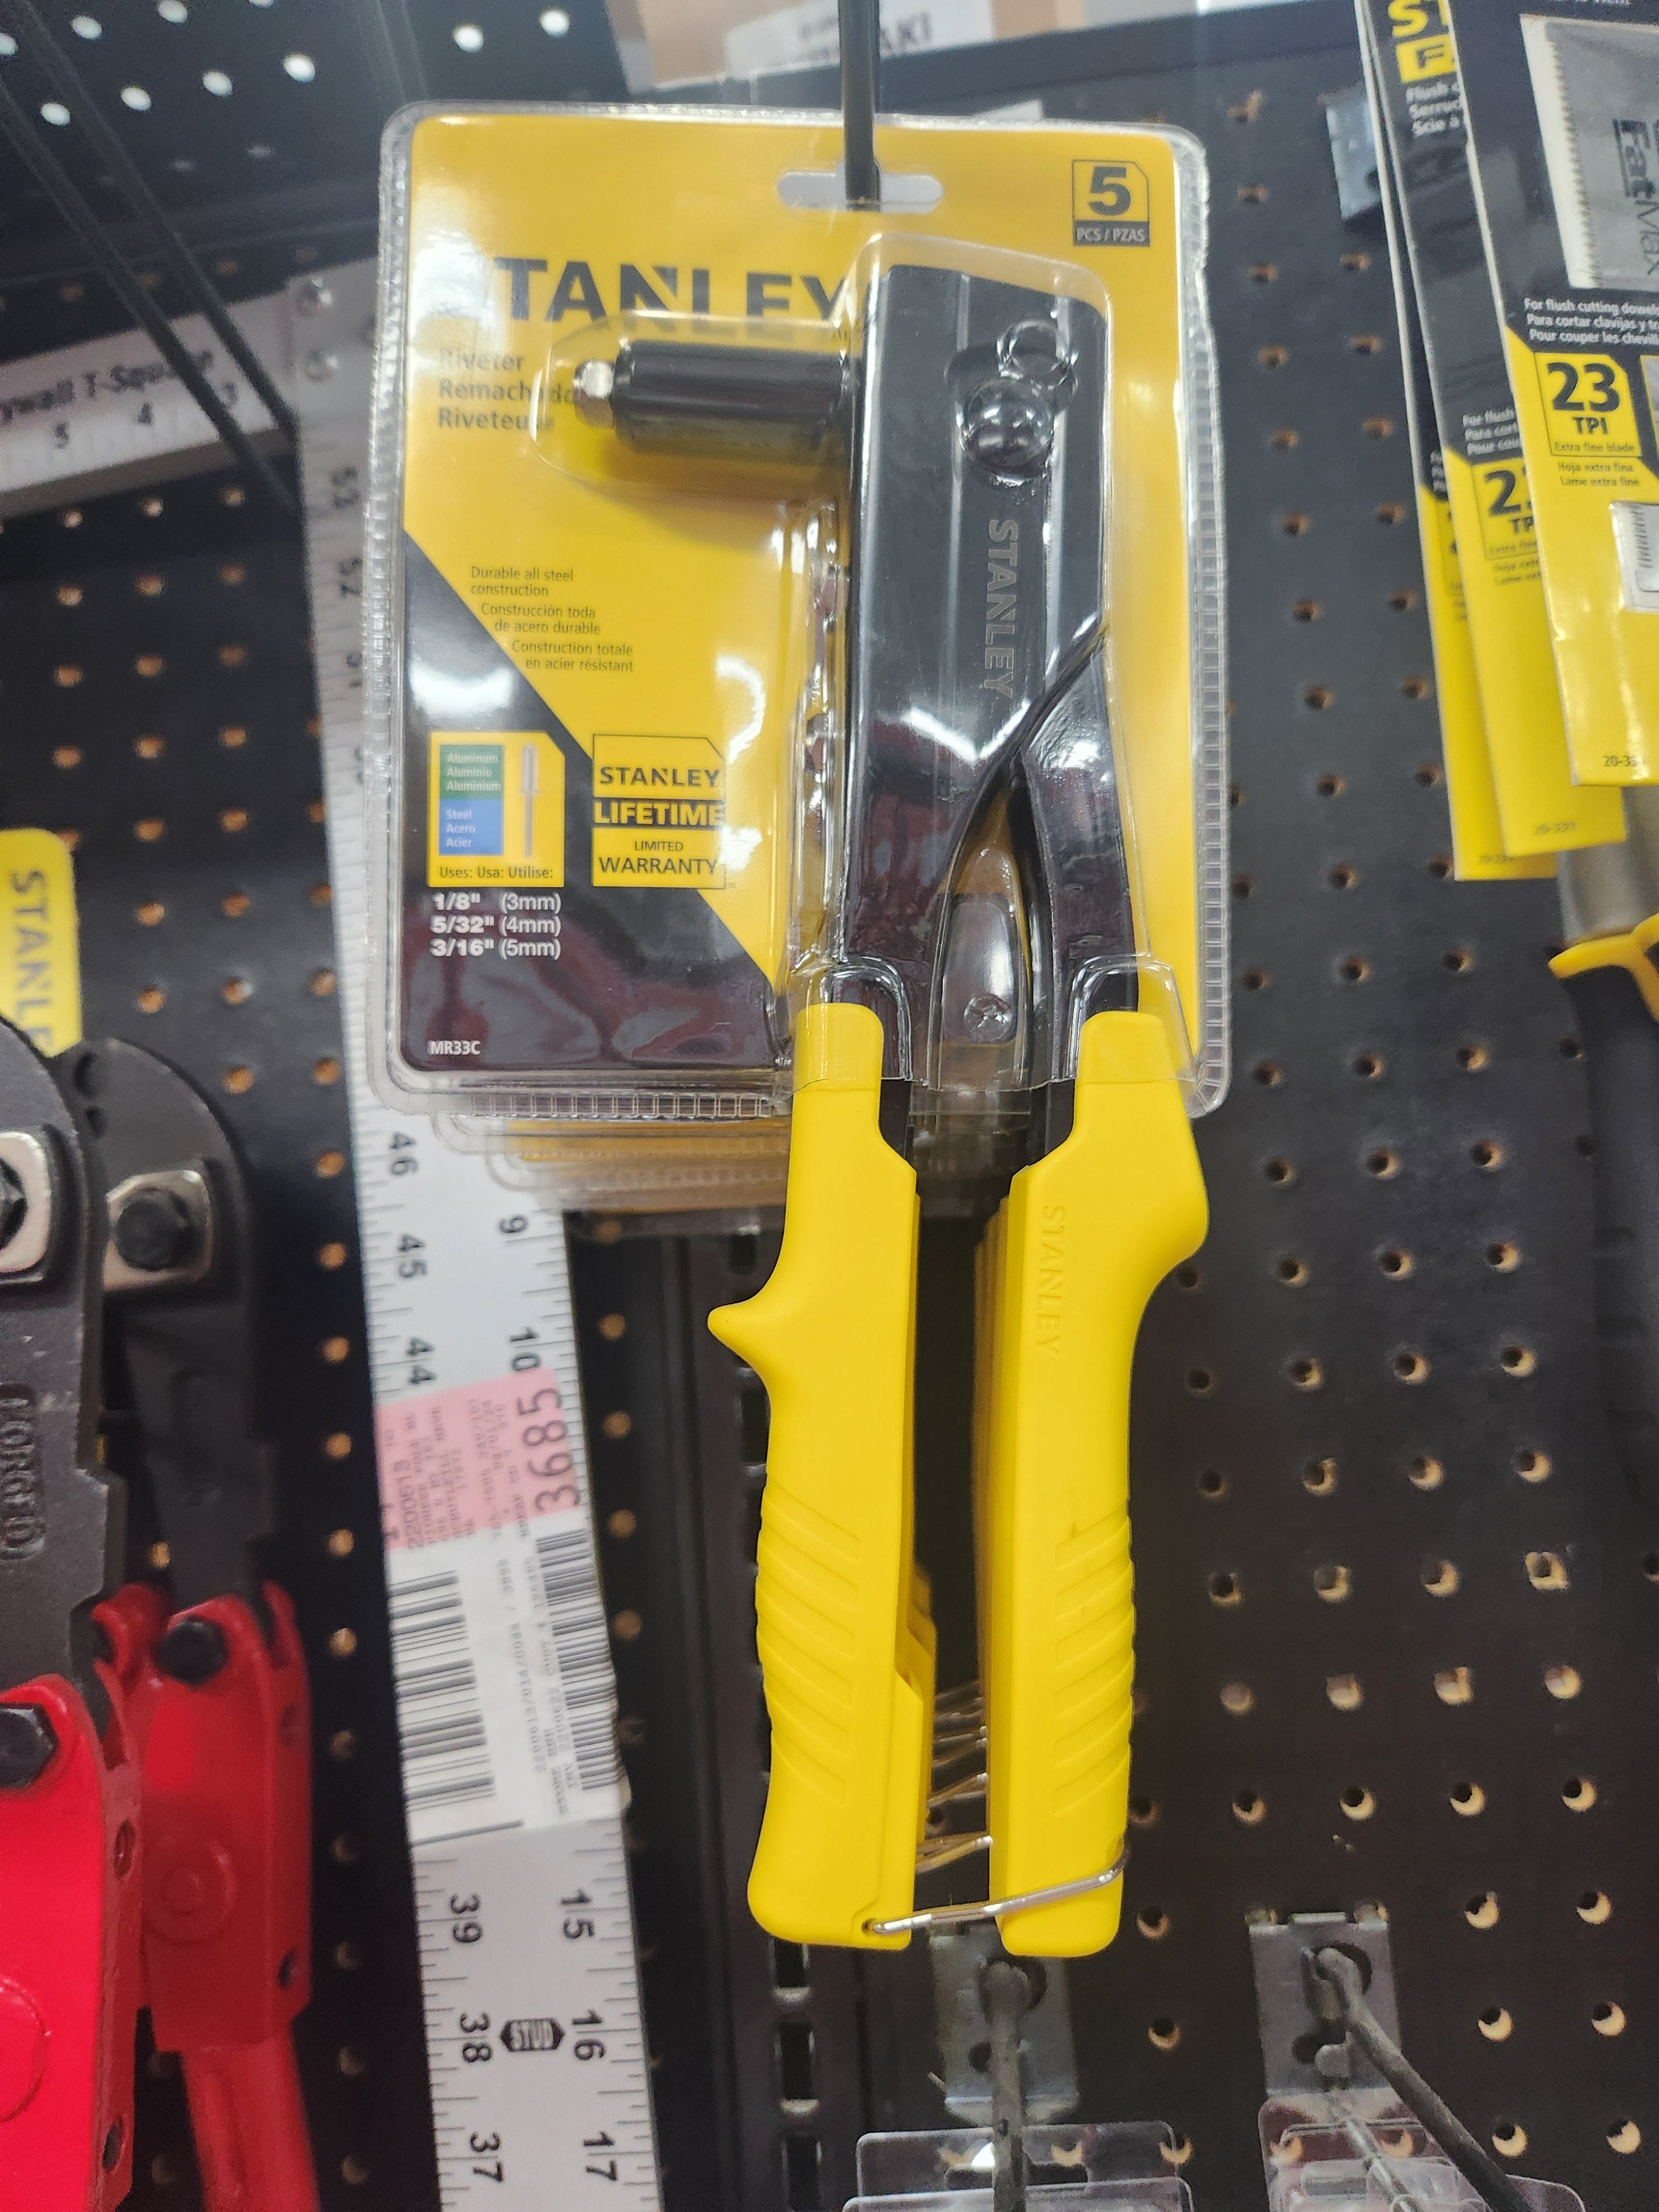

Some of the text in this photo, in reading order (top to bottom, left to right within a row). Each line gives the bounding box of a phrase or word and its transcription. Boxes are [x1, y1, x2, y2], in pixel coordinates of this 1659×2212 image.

[1088, 166, 1130, 216] 5
[1076, 228, 1100, 242] PCS
[1112, 228, 1145, 242] PZAS
[494, 257, 849, 338] TANLEY
[1524, 298, 1542, 311] For
[1545, 298, 1575, 312] flush
[1577, 300, 1619, 316] cutting
[1526, 313, 1553, 327] Para
[1555, 316, 1592, 328] cortar
[1594, 316, 1636, 331] clavijas
[1529, 328, 1557, 342] Pour
[1559, 331, 1600, 345] couper
[1602, 331, 1619, 343] les
[1547, 362, 1620, 413] 23
[1572, 417, 1608, 435] TPI
[1555, 442, 1634, 453] Extra fine blade
[1584, 463, 1611, 473] extra
[1484, 465, 1531, 516] 2
[1561, 476, 1640, 487] Lame extra fine
[472, 566, 573, 582] Durable all steel
[471, 584, 549, 597] construction
[481, 603, 596, 618] Construcción toda
[984, 519, 1018, 699] STANLEY
[494, 620, 601, 635] de acero durable
[513, 640, 633, 656] Construction totale
[526, 658, 634, 672] en acier résistant
[446, 753, 498, 764] Aluminum
[446, 767, 492, 778] Aluminio
[600, 766, 721, 787] STANLEY
[446, 781, 501, 791] Aluminium
[446, 809, 472, 820] Steel
[446, 823, 476, 834] Acero
[446, 837, 472, 848] Acier
[634, 841, 684, 852] LIMITED
[440, 865, 553, 879] Uses: Usa: Utilise:
[599, 857, 718, 875] WARRANTY
[432, 891, 561, 914] 1/8" (3mm)
[430, 915, 561, 937] 5/32" (4mm)
[430, 938, 561, 960] 3/16" (5mm)
[429, 1040, 481, 1056] MR33C
[389, 1131, 419, 1177] 46
[398, 1233, 428, 1279] 45
[1036, 1204, 1065, 1358] STANLEY
[509, 1327, 541, 1371] 10
[405, 1337, 437, 1385] 44
[516, 1387, 581, 1512] 3685
[449, 1892, 483, 1944] 39
[560, 1889, 596, 1939] 15
[459, 2011, 494, 2064] 38
[571, 2008, 606, 2061] 16
[469, 2131, 504, 2183] 37
[583, 2131, 618, 2182] 17
